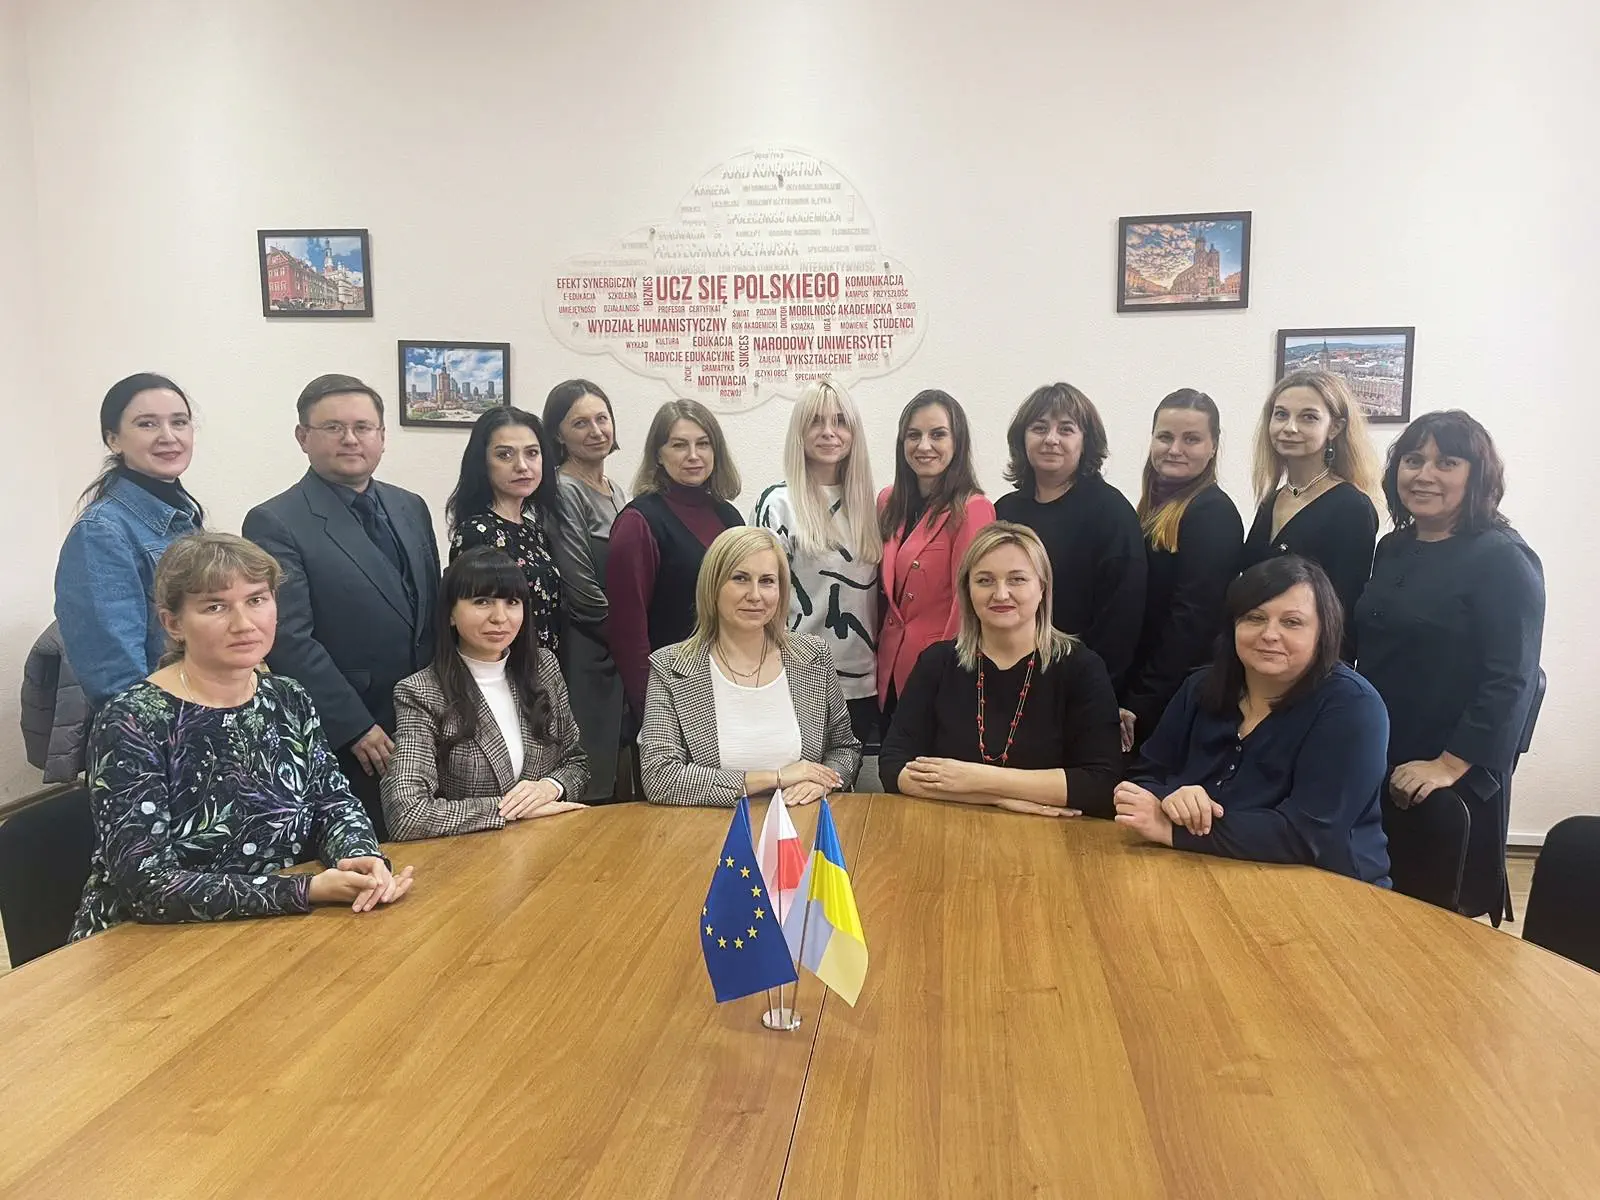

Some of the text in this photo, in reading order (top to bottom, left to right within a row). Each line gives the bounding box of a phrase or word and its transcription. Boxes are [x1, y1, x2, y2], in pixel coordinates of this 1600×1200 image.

[557, 278, 637, 288] EFEKT SYNERGICZNY
[845, 275, 903, 287] KOMUNIKACJA
[644, 276, 653, 306] BIZNES
[657, 272, 839, 304] UCZ SIĘ POLSKIEGO
[756, 308, 776, 316] POZIOM
[789, 303, 892, 316] MOBILNOŚĆ AKADEMICKA
[588, 318, 727, 333] WYDZIAŁ HUMANISTYCZNY
[744, 321, 777, 329] AKADEMICKI
[873, 318, 913, 329] STUDENCI
[693, 336, 732, 346] EDUKACJA
[753, 335, 893, 350] NARODOWY UNIWERSYTET
[644, 351, 734, 362] TRADYCJE EDUKACYJNE
[739, 335, 749, 367] SUKCES
[785, 354, 852, 364] WYKSZTAŁCENIE
[774, 369, 787, 377] OBCE
[698, 376, 746, 386] MOTYWACJA
